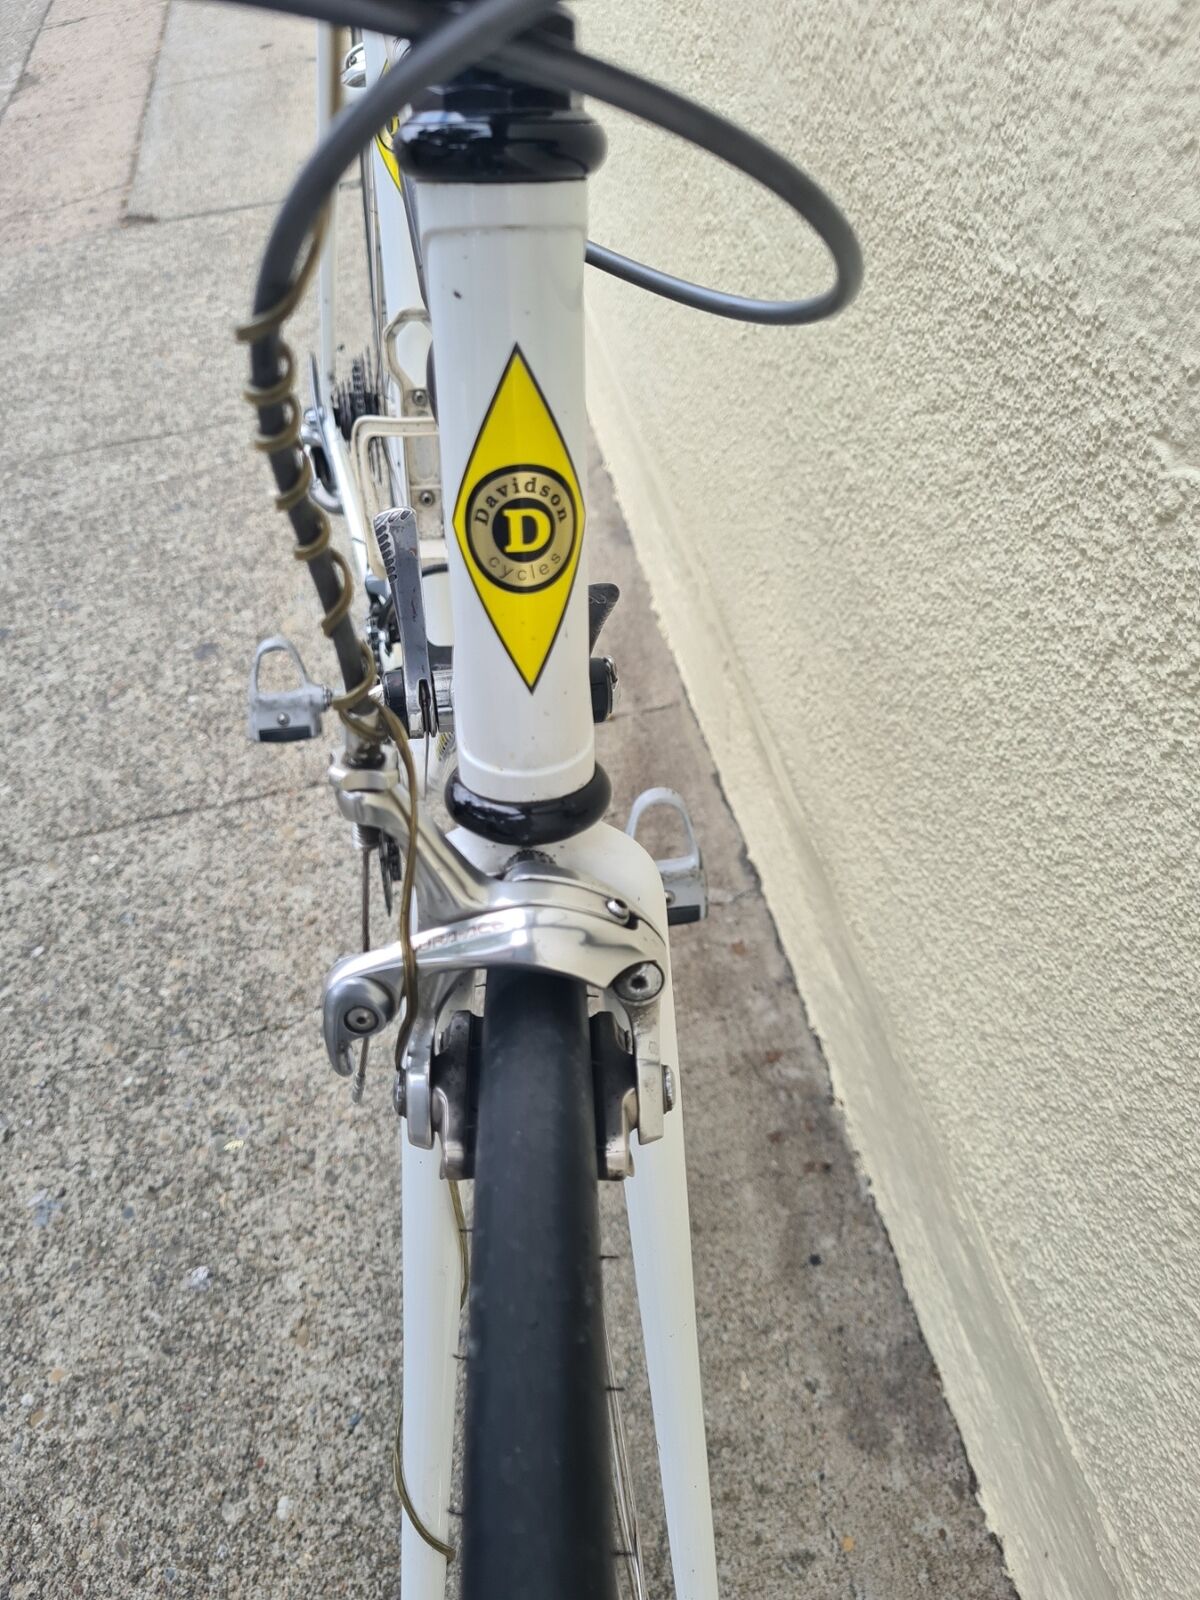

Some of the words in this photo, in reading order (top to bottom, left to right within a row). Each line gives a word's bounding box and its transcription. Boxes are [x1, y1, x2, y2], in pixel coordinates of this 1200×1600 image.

[475, 477, 567, 526] Davidson
[503, 508, 552, 553] D
[488, 553, 561, 581] cycles
